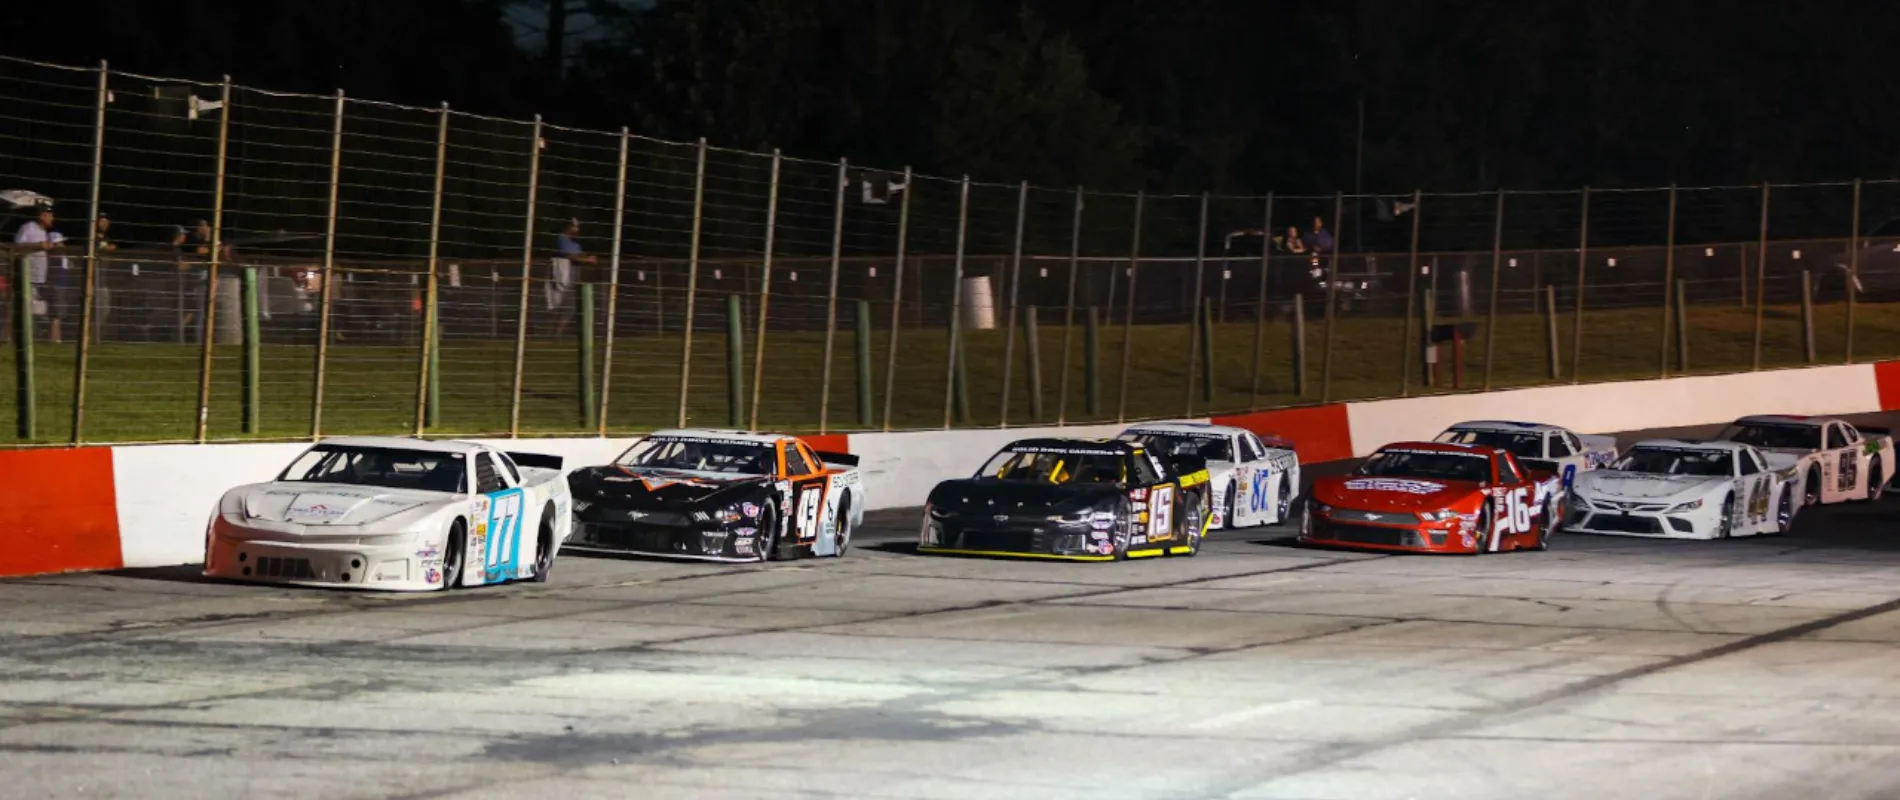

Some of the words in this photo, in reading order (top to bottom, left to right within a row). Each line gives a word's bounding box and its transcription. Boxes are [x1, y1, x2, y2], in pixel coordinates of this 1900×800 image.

[796, 487, 821, 539] 43
[1148, 486, 1173, 539] 15
[1251, 468, 1269, 513] 87
[1505, 487, 1531, 534] 16
[488, 493, 521, 568] 77
